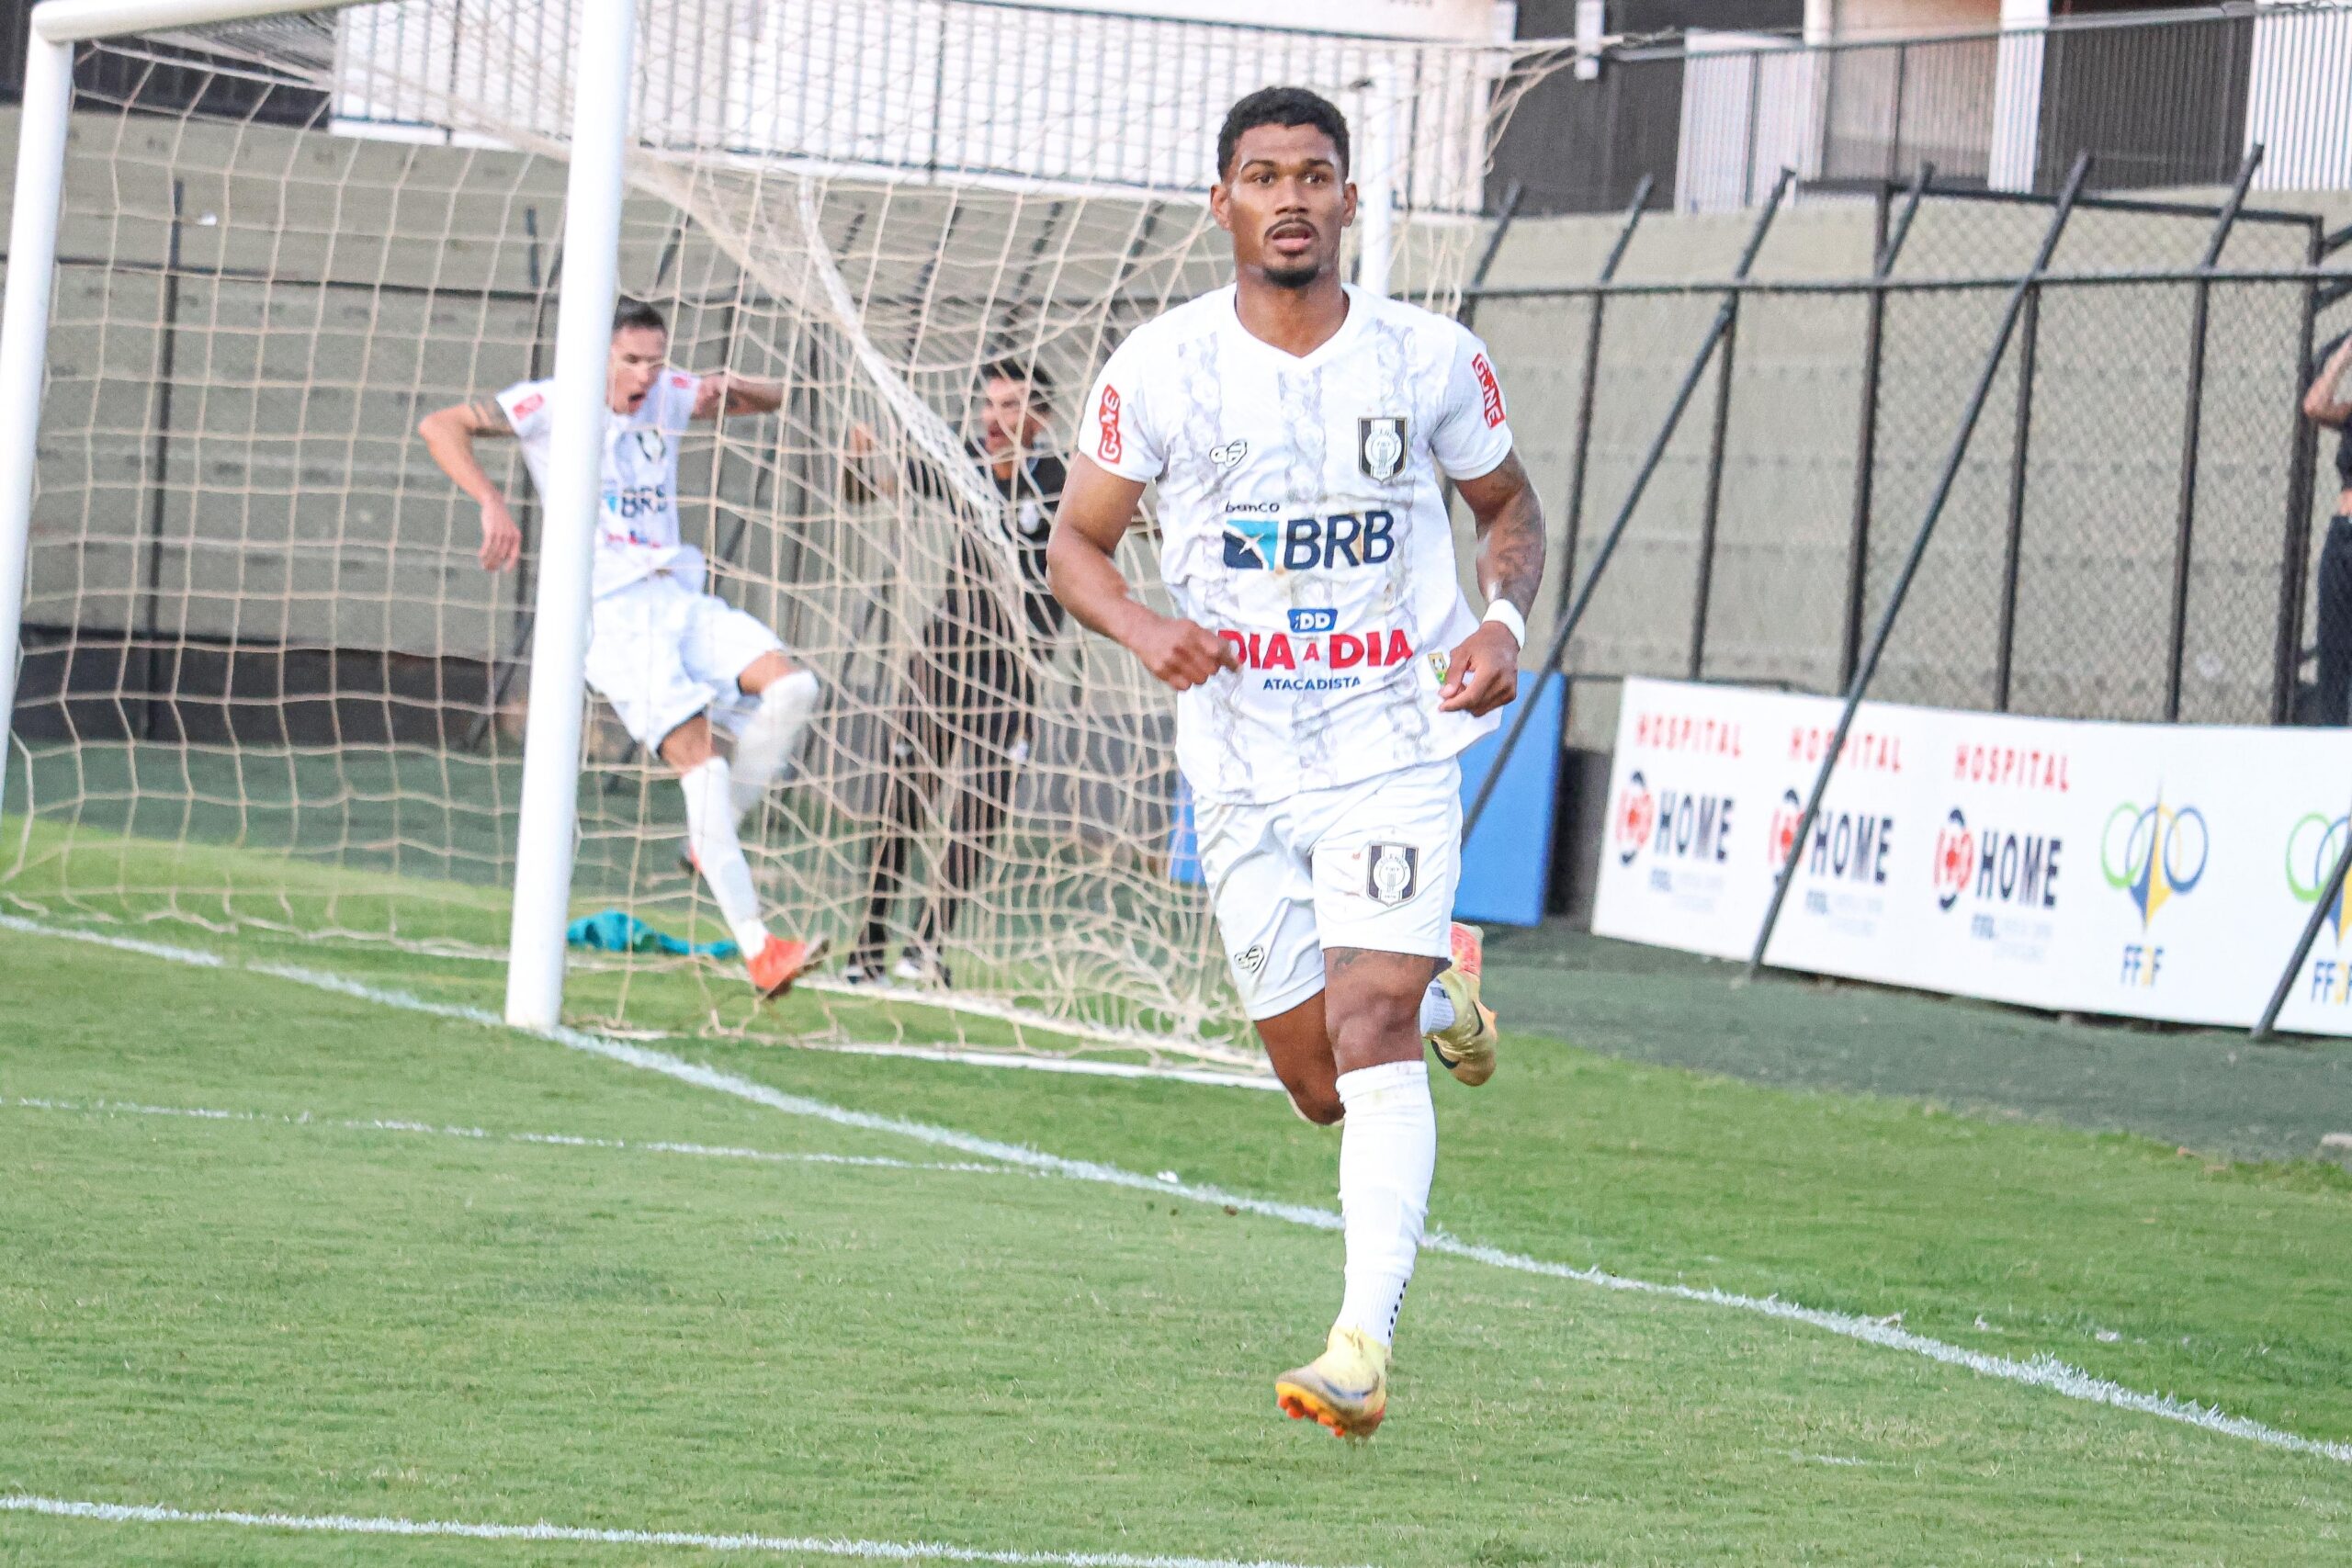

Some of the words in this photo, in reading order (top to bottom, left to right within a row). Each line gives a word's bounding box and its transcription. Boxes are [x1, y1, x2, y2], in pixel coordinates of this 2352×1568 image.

[1225, 500, 1280, 513] banco
[1283, 510, 1395, 570] BRB
[1302, 642, 1320, 662] A
[1329, 628, 1414, 670] DIA
[1262, 675, 1362, 691] ATACADISTA
[1637, 714, 1741, 757] HOSPITAL
[1953, 742, 2070, 793] HOSPITAL
[1656, 790, 1734, 861] HOME
[1810, 811, 1894, 885] HOME
[1975, 829, 2063, 908] HOME
